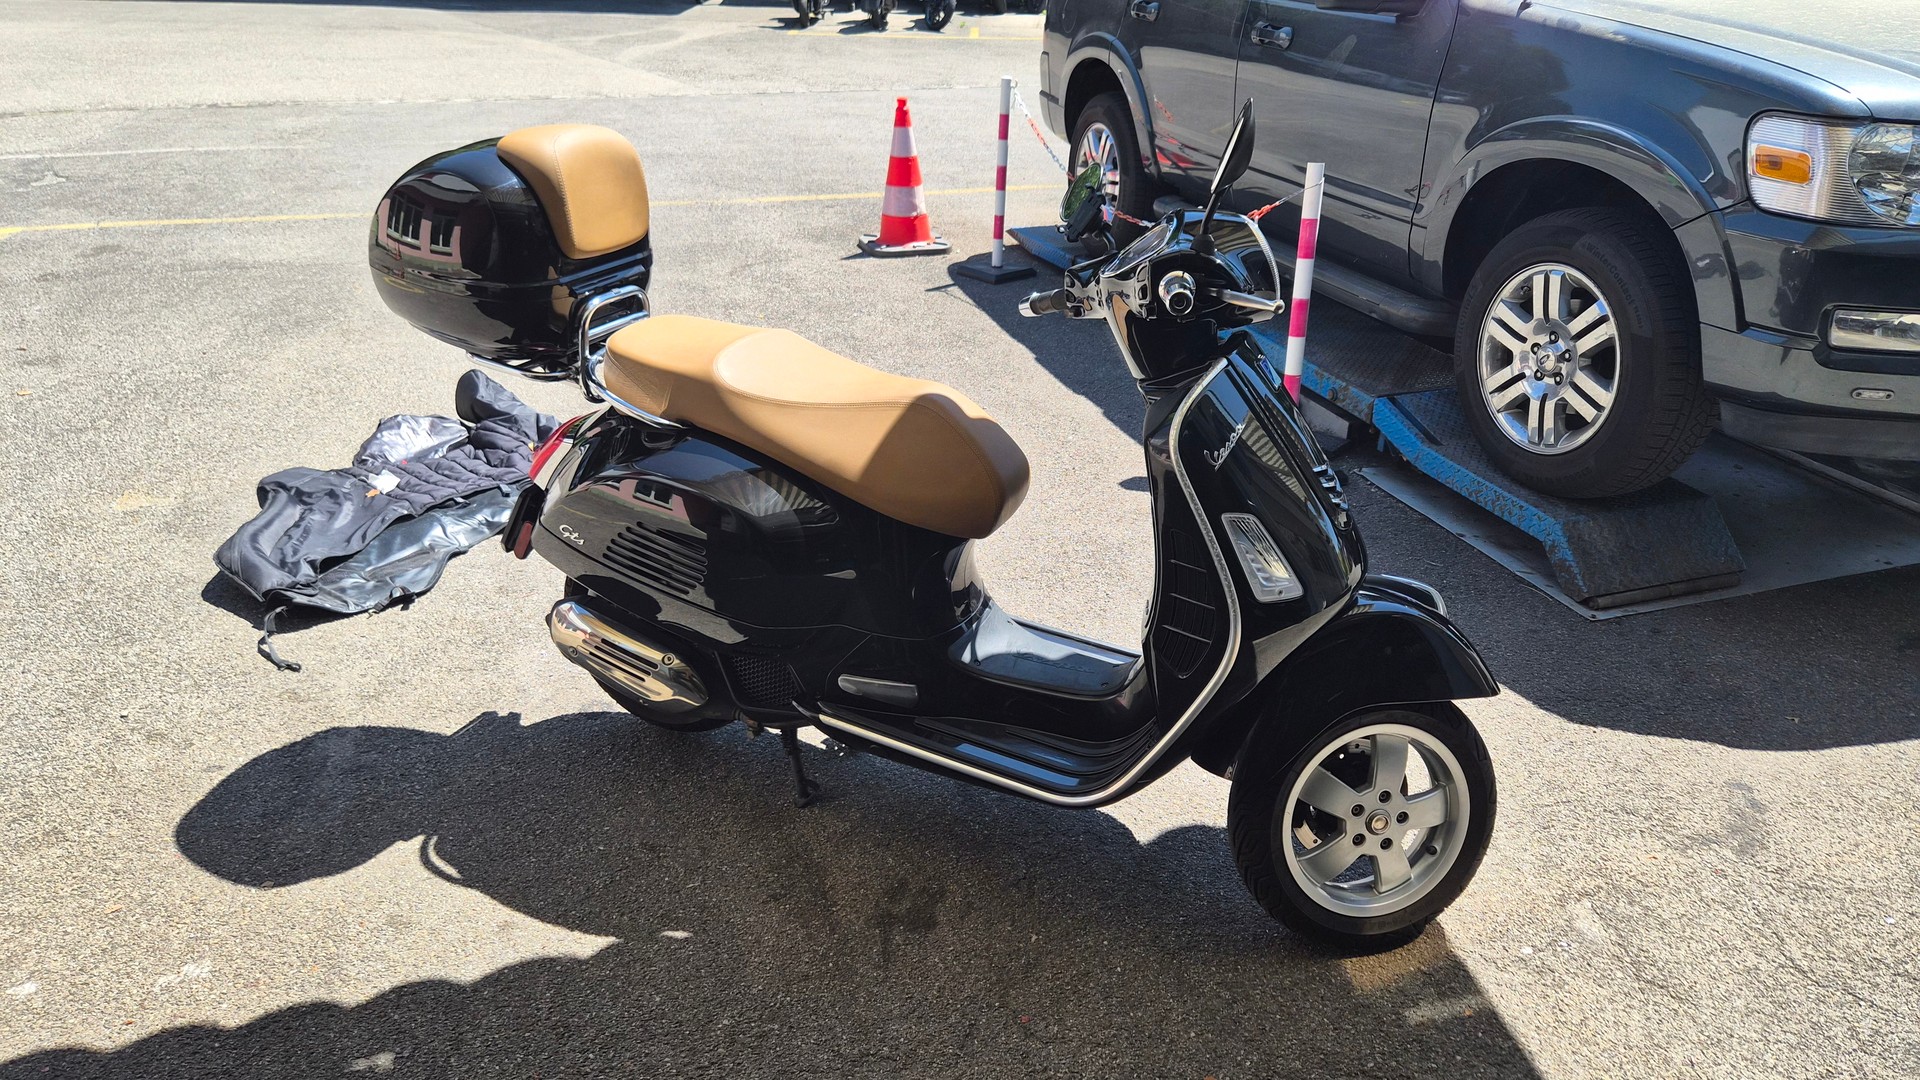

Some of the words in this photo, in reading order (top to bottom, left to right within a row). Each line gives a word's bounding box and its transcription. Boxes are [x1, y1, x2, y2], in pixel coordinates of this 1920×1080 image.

[1586, 242, 1636, 305] WinterContact
[1203, 423, 1247, 472] Vespa
[559, 524, 585, 545] Gts
